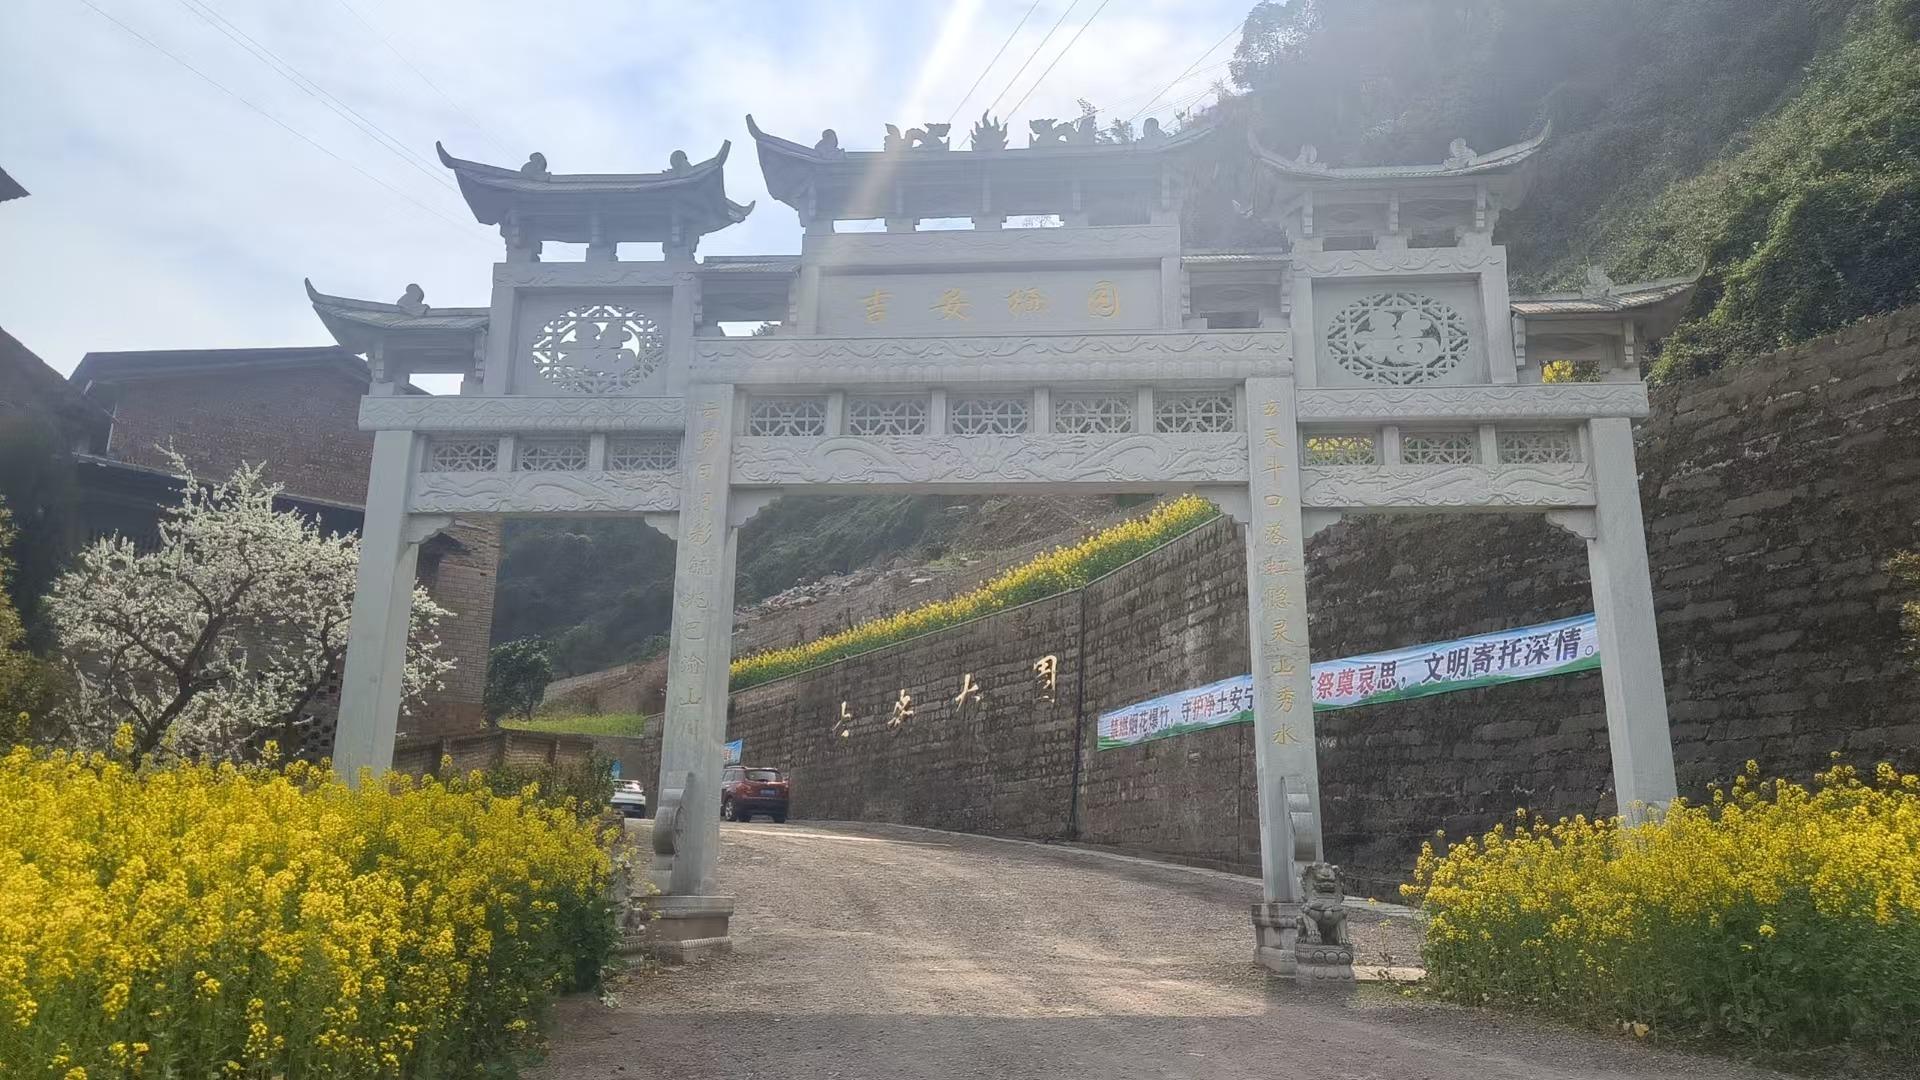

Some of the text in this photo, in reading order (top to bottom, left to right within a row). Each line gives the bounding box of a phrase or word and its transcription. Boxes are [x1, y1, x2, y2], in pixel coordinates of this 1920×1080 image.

[1311, 627, 1595, 700] 祭奠哀思，文明寄托深情。
